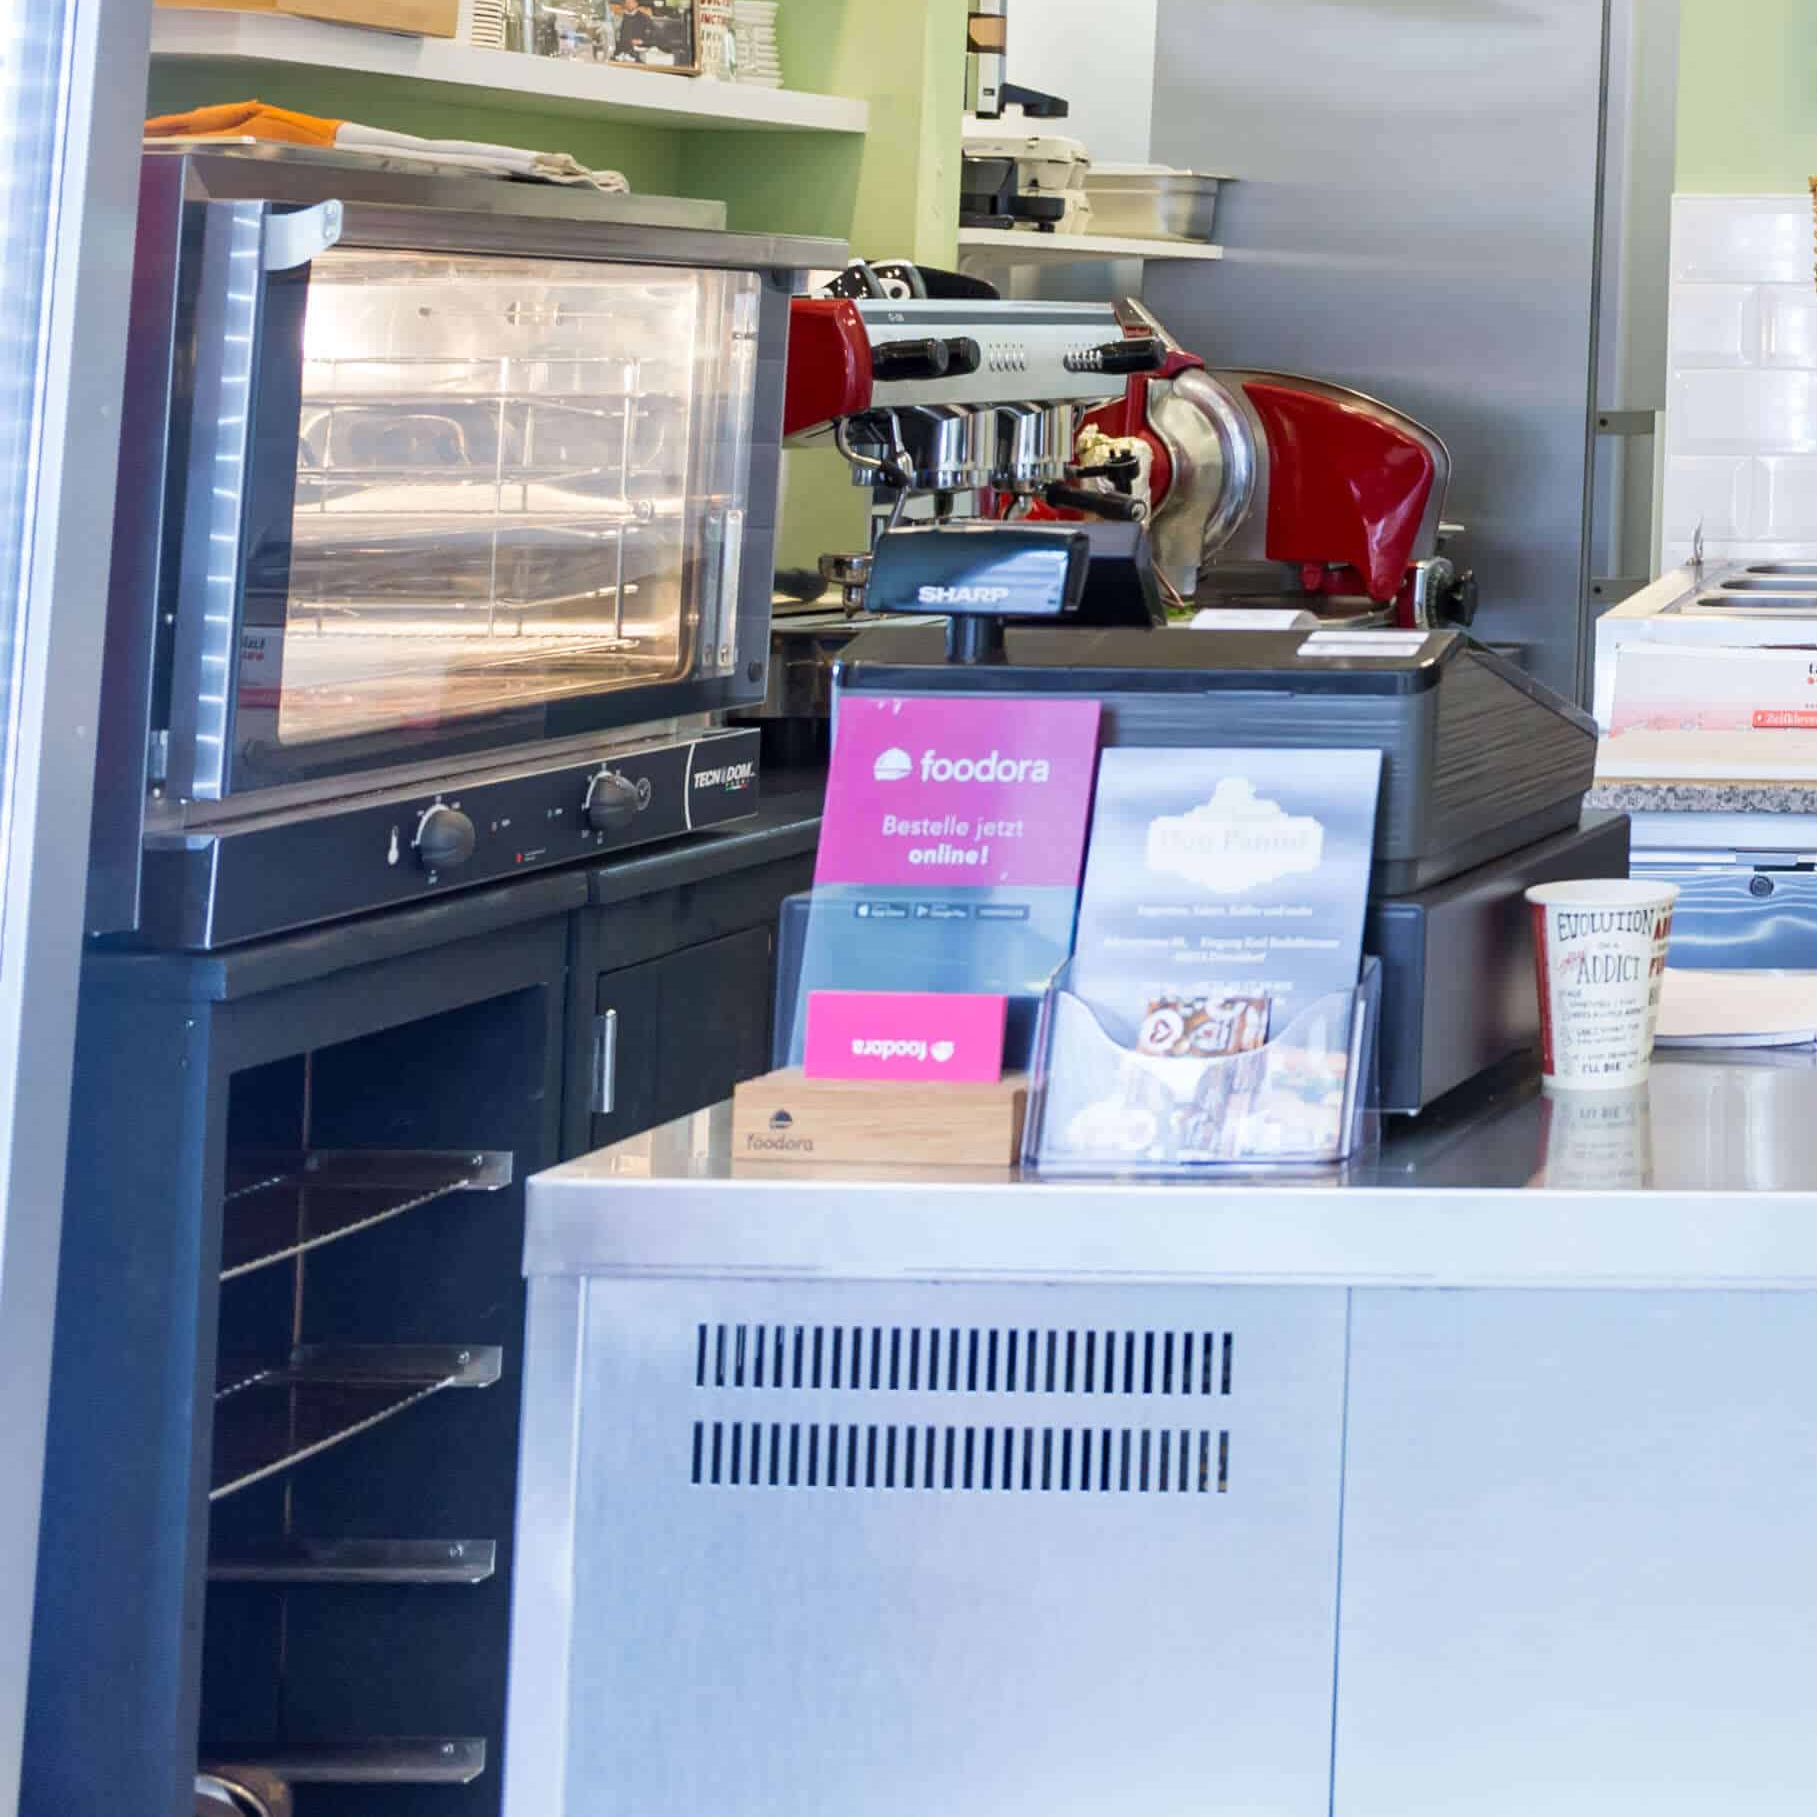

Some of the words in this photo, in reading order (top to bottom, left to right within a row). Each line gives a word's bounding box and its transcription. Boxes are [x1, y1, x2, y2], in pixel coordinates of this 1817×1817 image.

[917, 585, 1009, 604] SHARP
[920, 749, 1050, 784] foodora
[881, 814, 971, 838] Bestelle
[974, 815, 1025, 842] jetzt
[907, 843, 990, 866] online!
[1557, 908, 1655, 942] EVOLUTION
[1576, 954, 1641, 985] ADDICT
[851, 1039, 930, 1061] foodora
[746, 1131, 815, 1152] foodora
